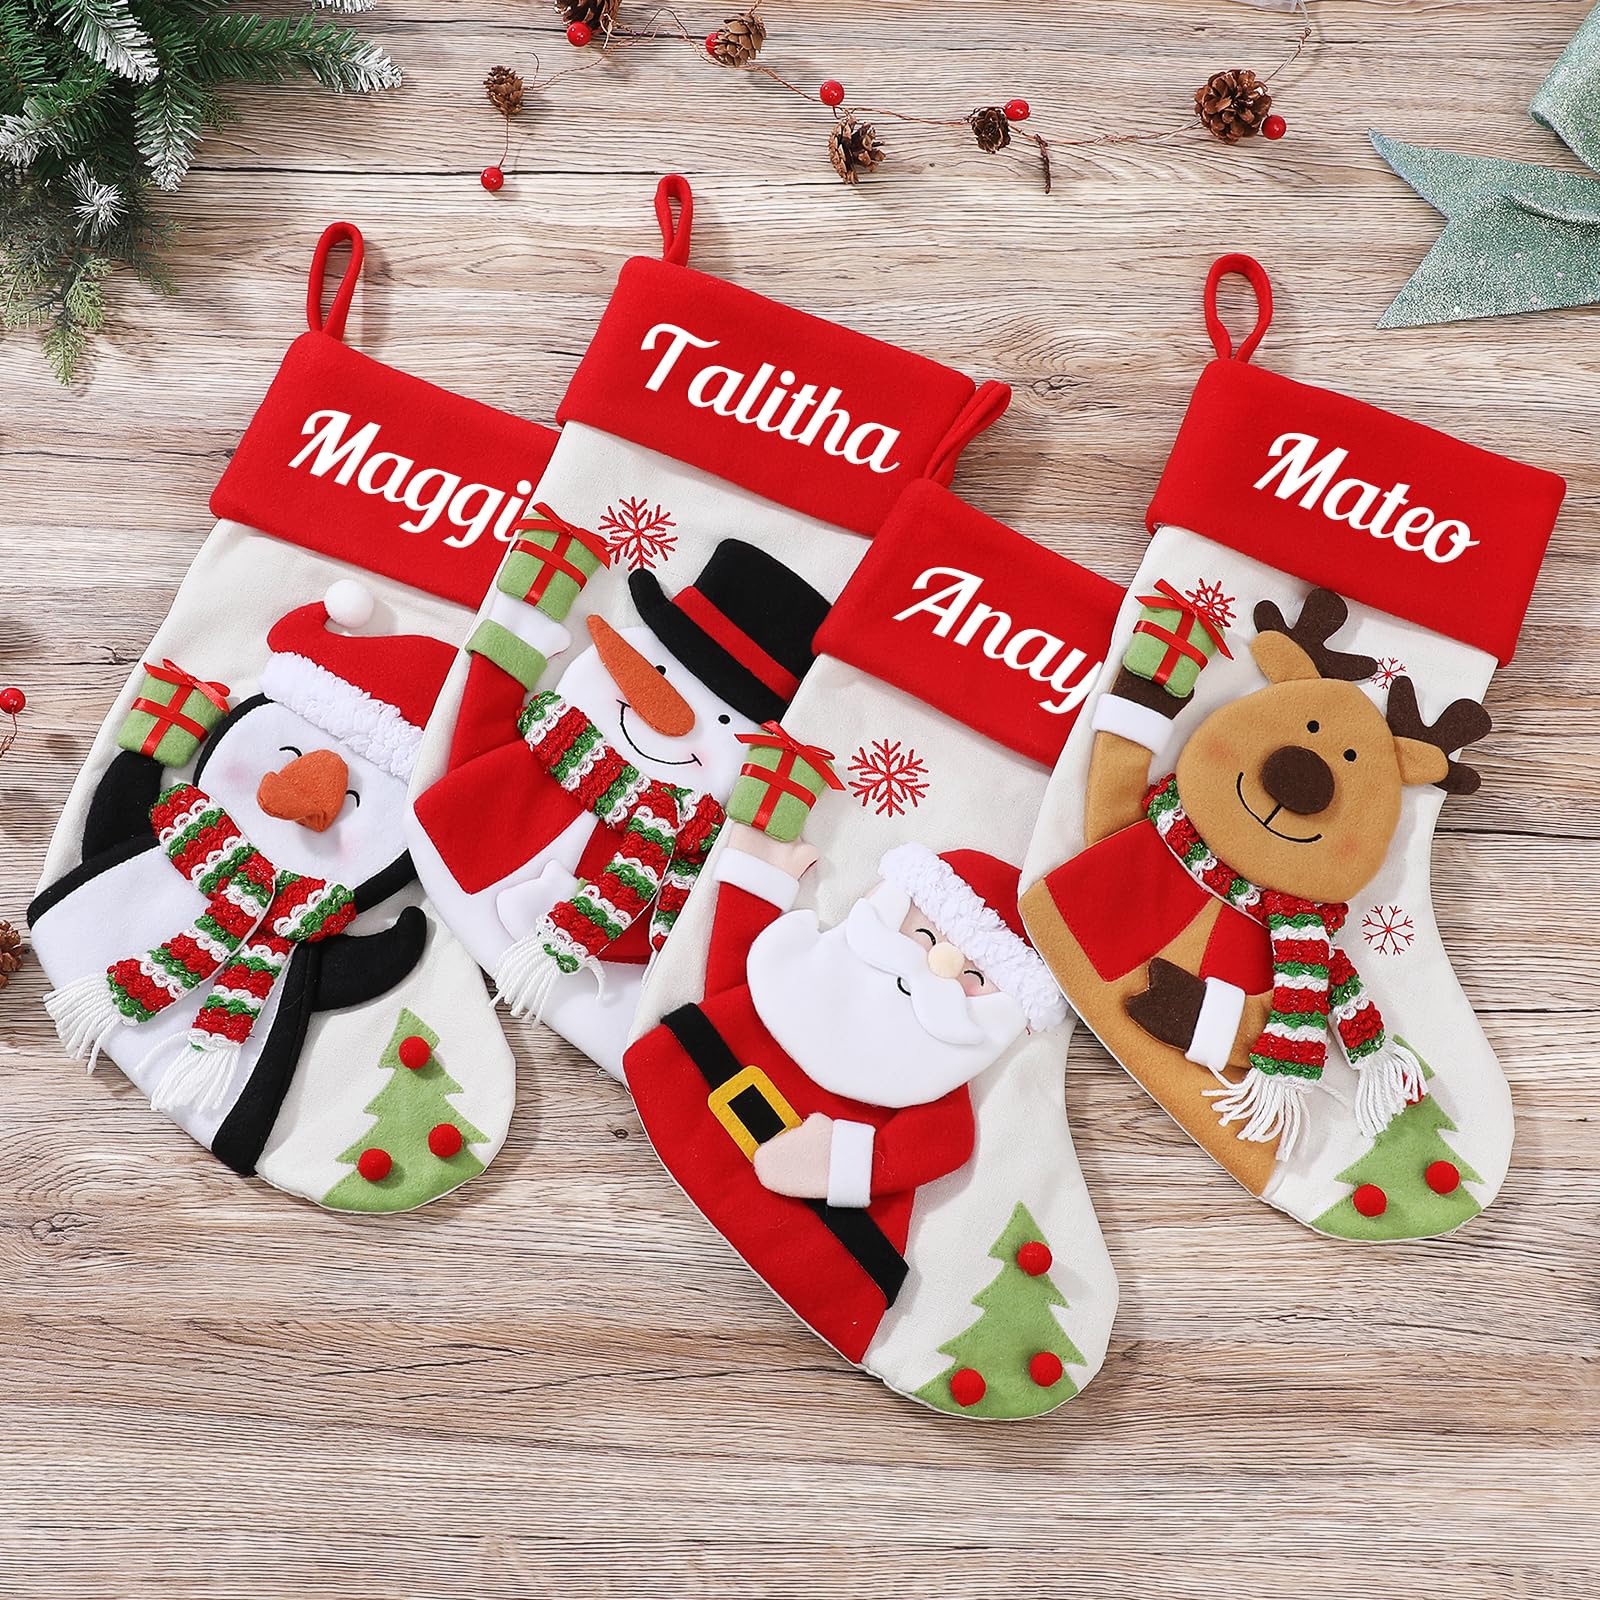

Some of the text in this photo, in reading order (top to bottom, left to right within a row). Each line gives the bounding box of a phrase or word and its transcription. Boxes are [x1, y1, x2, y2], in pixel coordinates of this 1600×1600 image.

[640, 323, 901, 473] Talitha
[288, 409, 532, 548] Maggi
[1252, 432, 1481, 563] Mateo
[892, 566, 1103, 715] Anay
